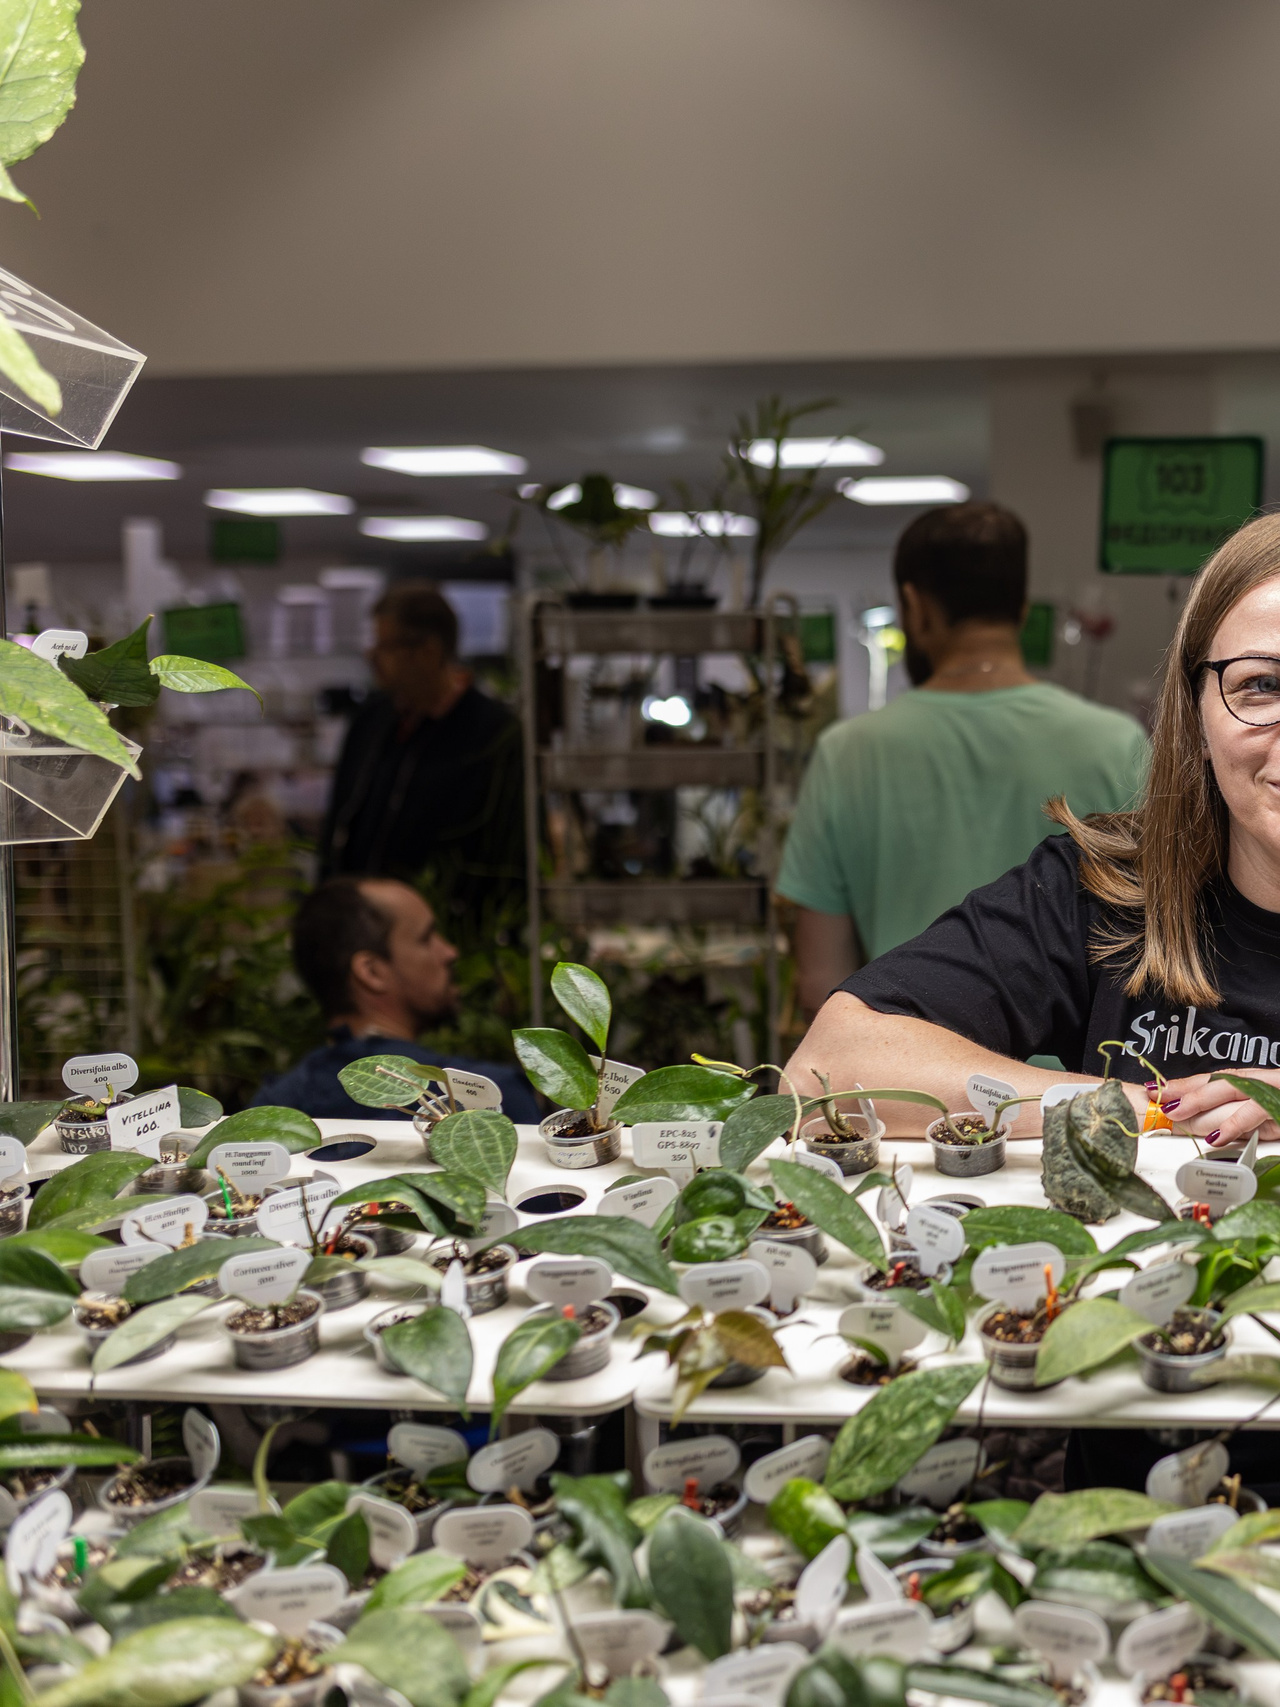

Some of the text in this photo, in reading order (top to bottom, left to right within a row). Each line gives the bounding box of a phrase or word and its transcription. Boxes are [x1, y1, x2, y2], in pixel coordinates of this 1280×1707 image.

[70, 1061, 128, 1076] Diversifolia albo
[93, 1075, 108, 1084] 400
[604, 1084, 621, 1096] 650
[121, 1100, 172, 1126] VITELLINA
[659, 1129, 697, 1139] EPC-825
[671, 1153, 687, 1162] 350
